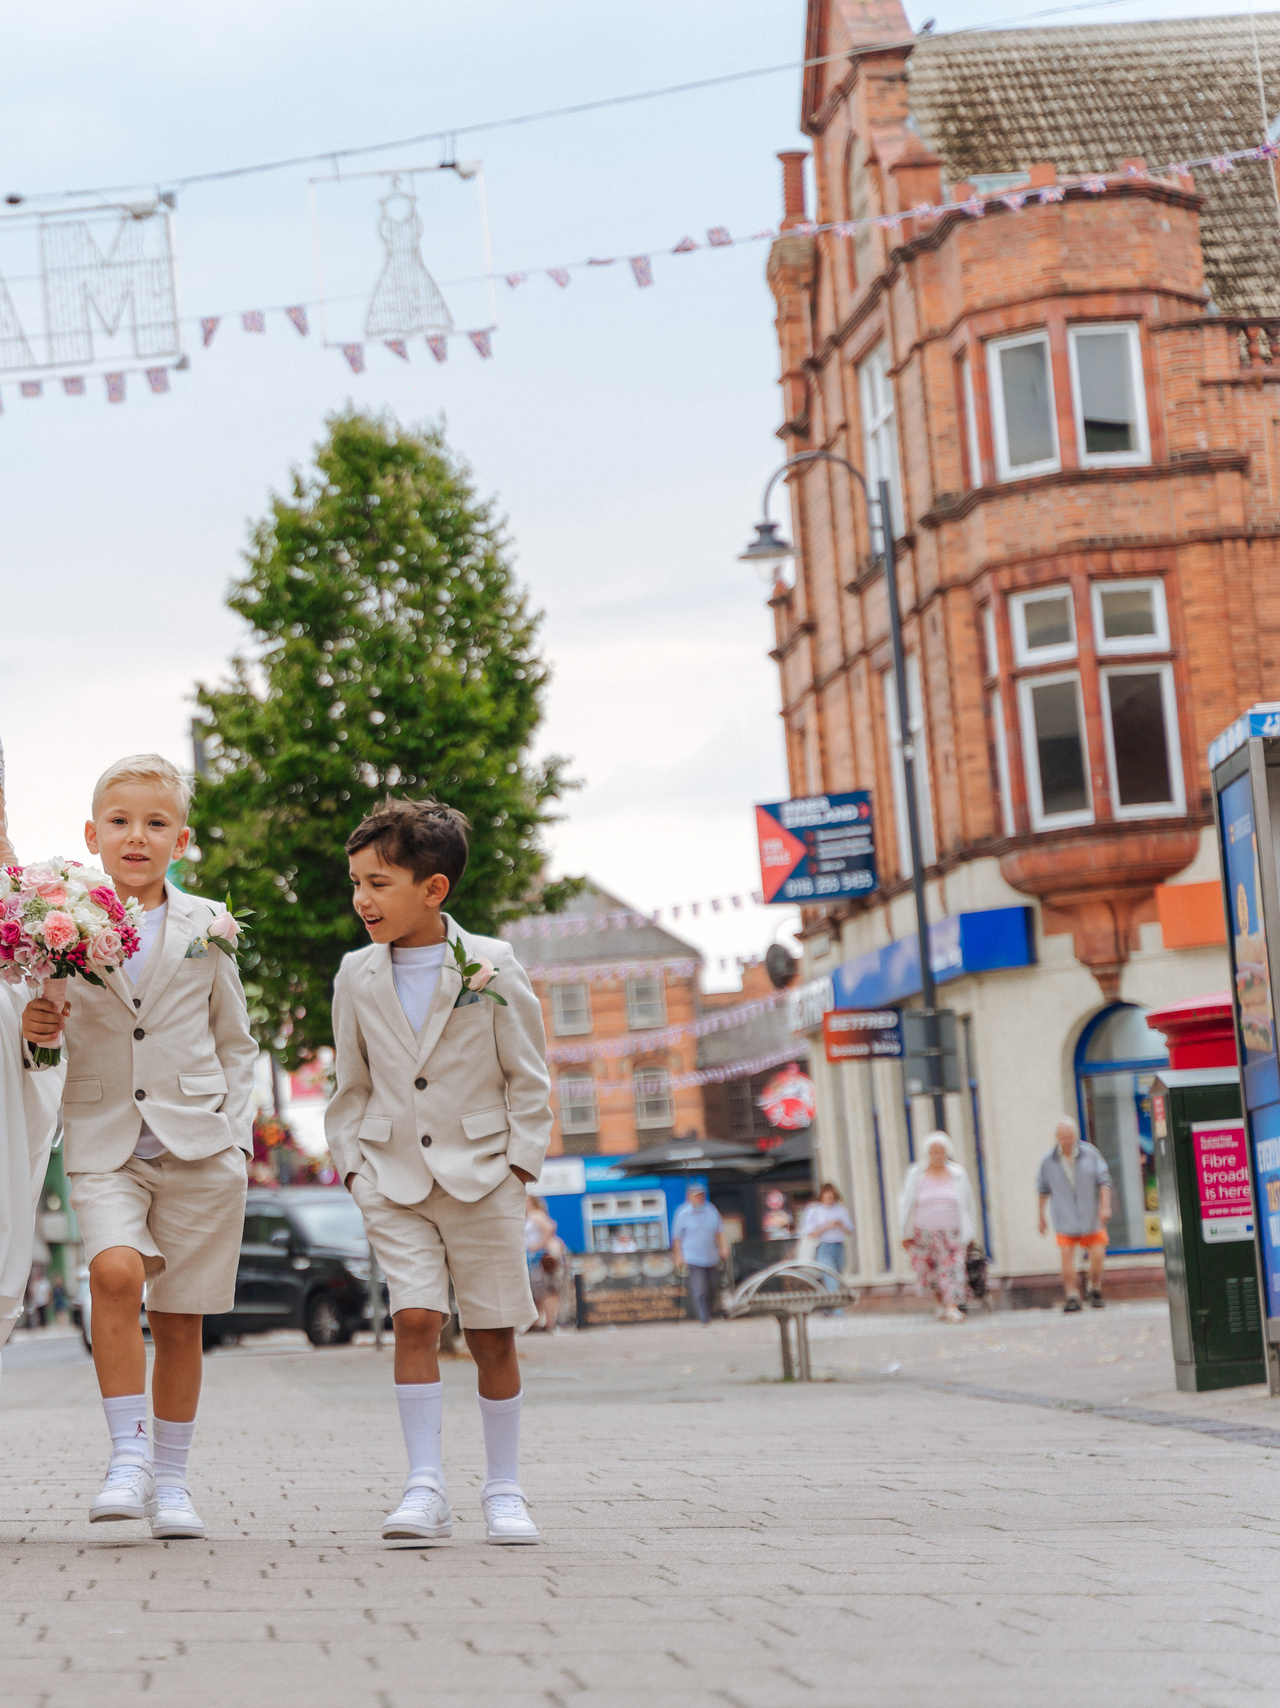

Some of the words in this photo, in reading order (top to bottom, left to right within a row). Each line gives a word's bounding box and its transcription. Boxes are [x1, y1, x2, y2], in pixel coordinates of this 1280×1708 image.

[828, 1011, 899, 1033] BETFRED
[830, 1042, 870, 1057] bonus
[871, 1039, 902, 1056] king
[1201, 1153, 1237, 1169] Fibre
[1205, 1186, 1217, 1200] is
[1218, 1184, 1251, 1199] here
